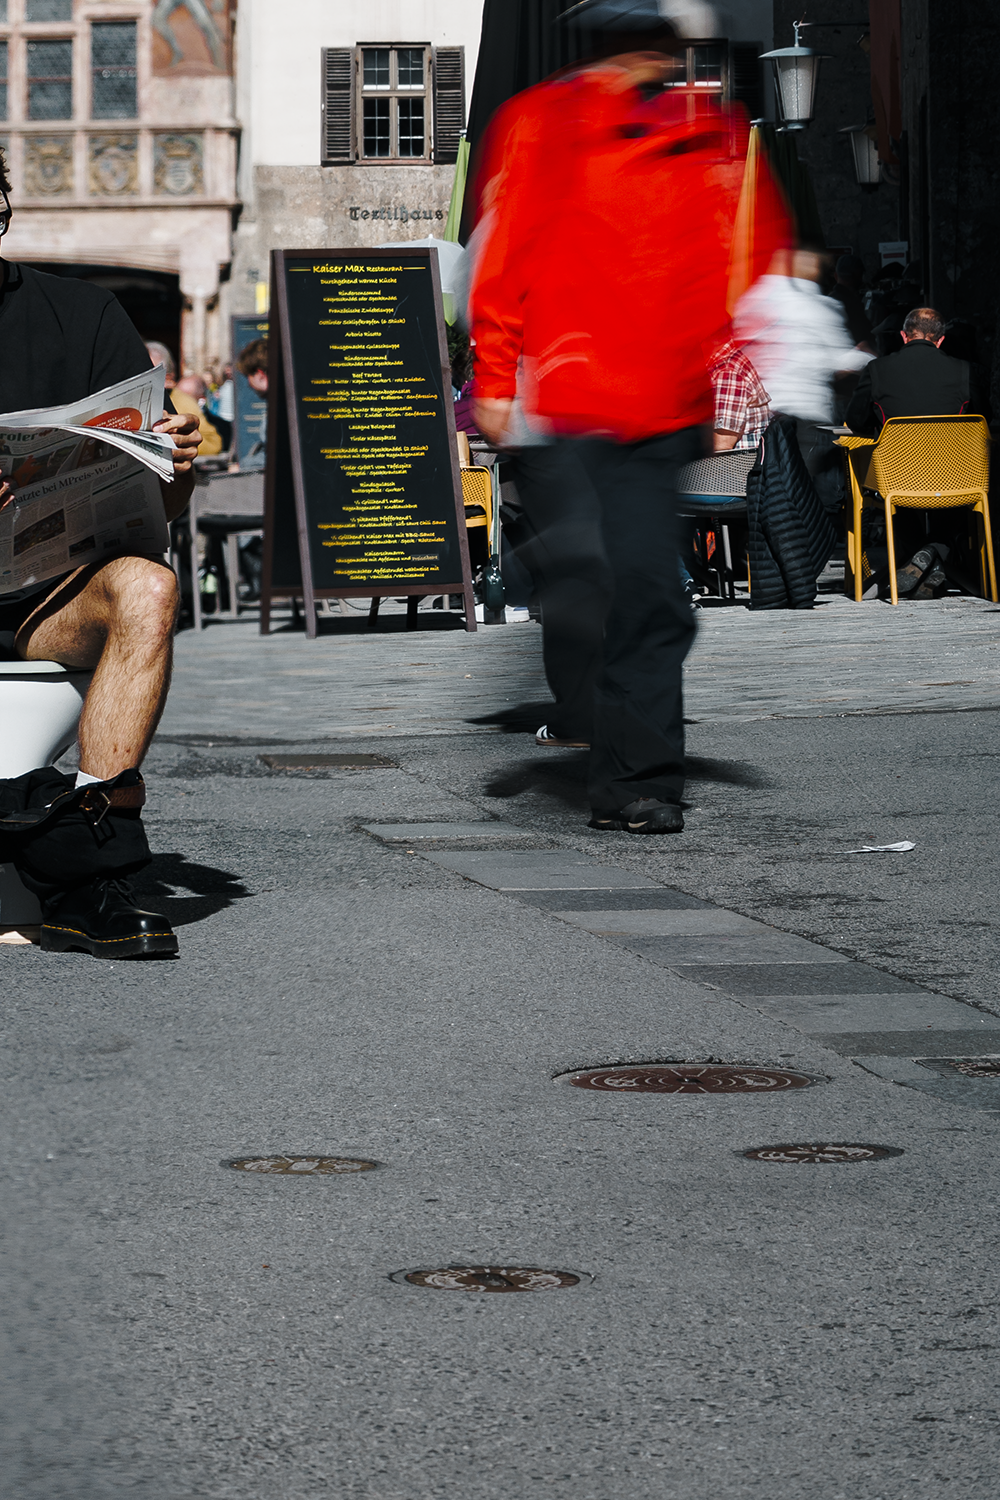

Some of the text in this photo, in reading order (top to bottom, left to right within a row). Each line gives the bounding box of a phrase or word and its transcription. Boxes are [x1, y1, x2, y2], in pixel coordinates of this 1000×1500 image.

[349, 206, 444, 223] Textilhaus
[313, 263, 343, 273] Kaiser
[344, 265, 365, 273] Max
[42, 483, 57, 494] bei
[59, 461, 118, 489] MPreis-Wahl
